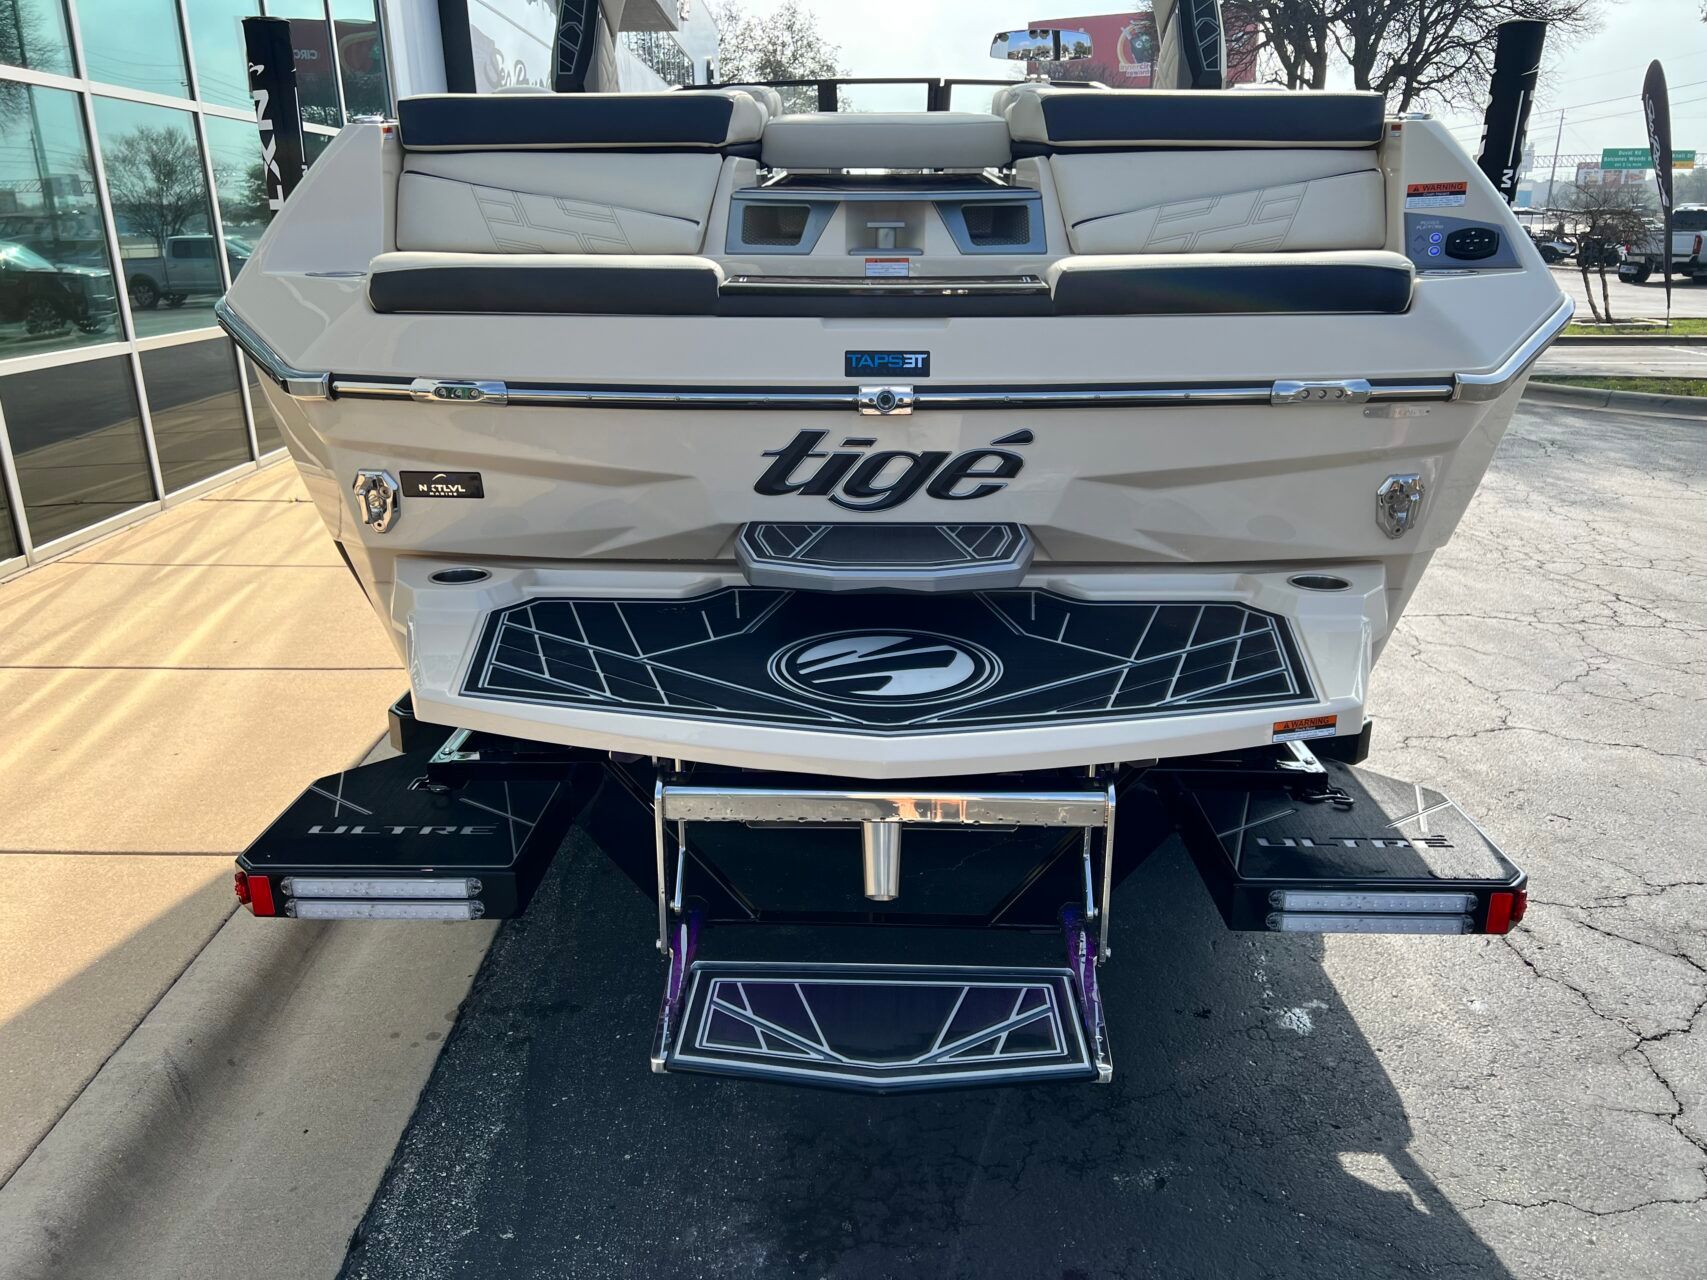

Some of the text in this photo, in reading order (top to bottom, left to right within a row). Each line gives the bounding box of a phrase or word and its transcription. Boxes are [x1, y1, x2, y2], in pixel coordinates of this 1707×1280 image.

[1423, 183, 1463, 191] WARNING
[753, 428, 1035, 513] tigé
[1291, 717, 1329, 728] WARNING
